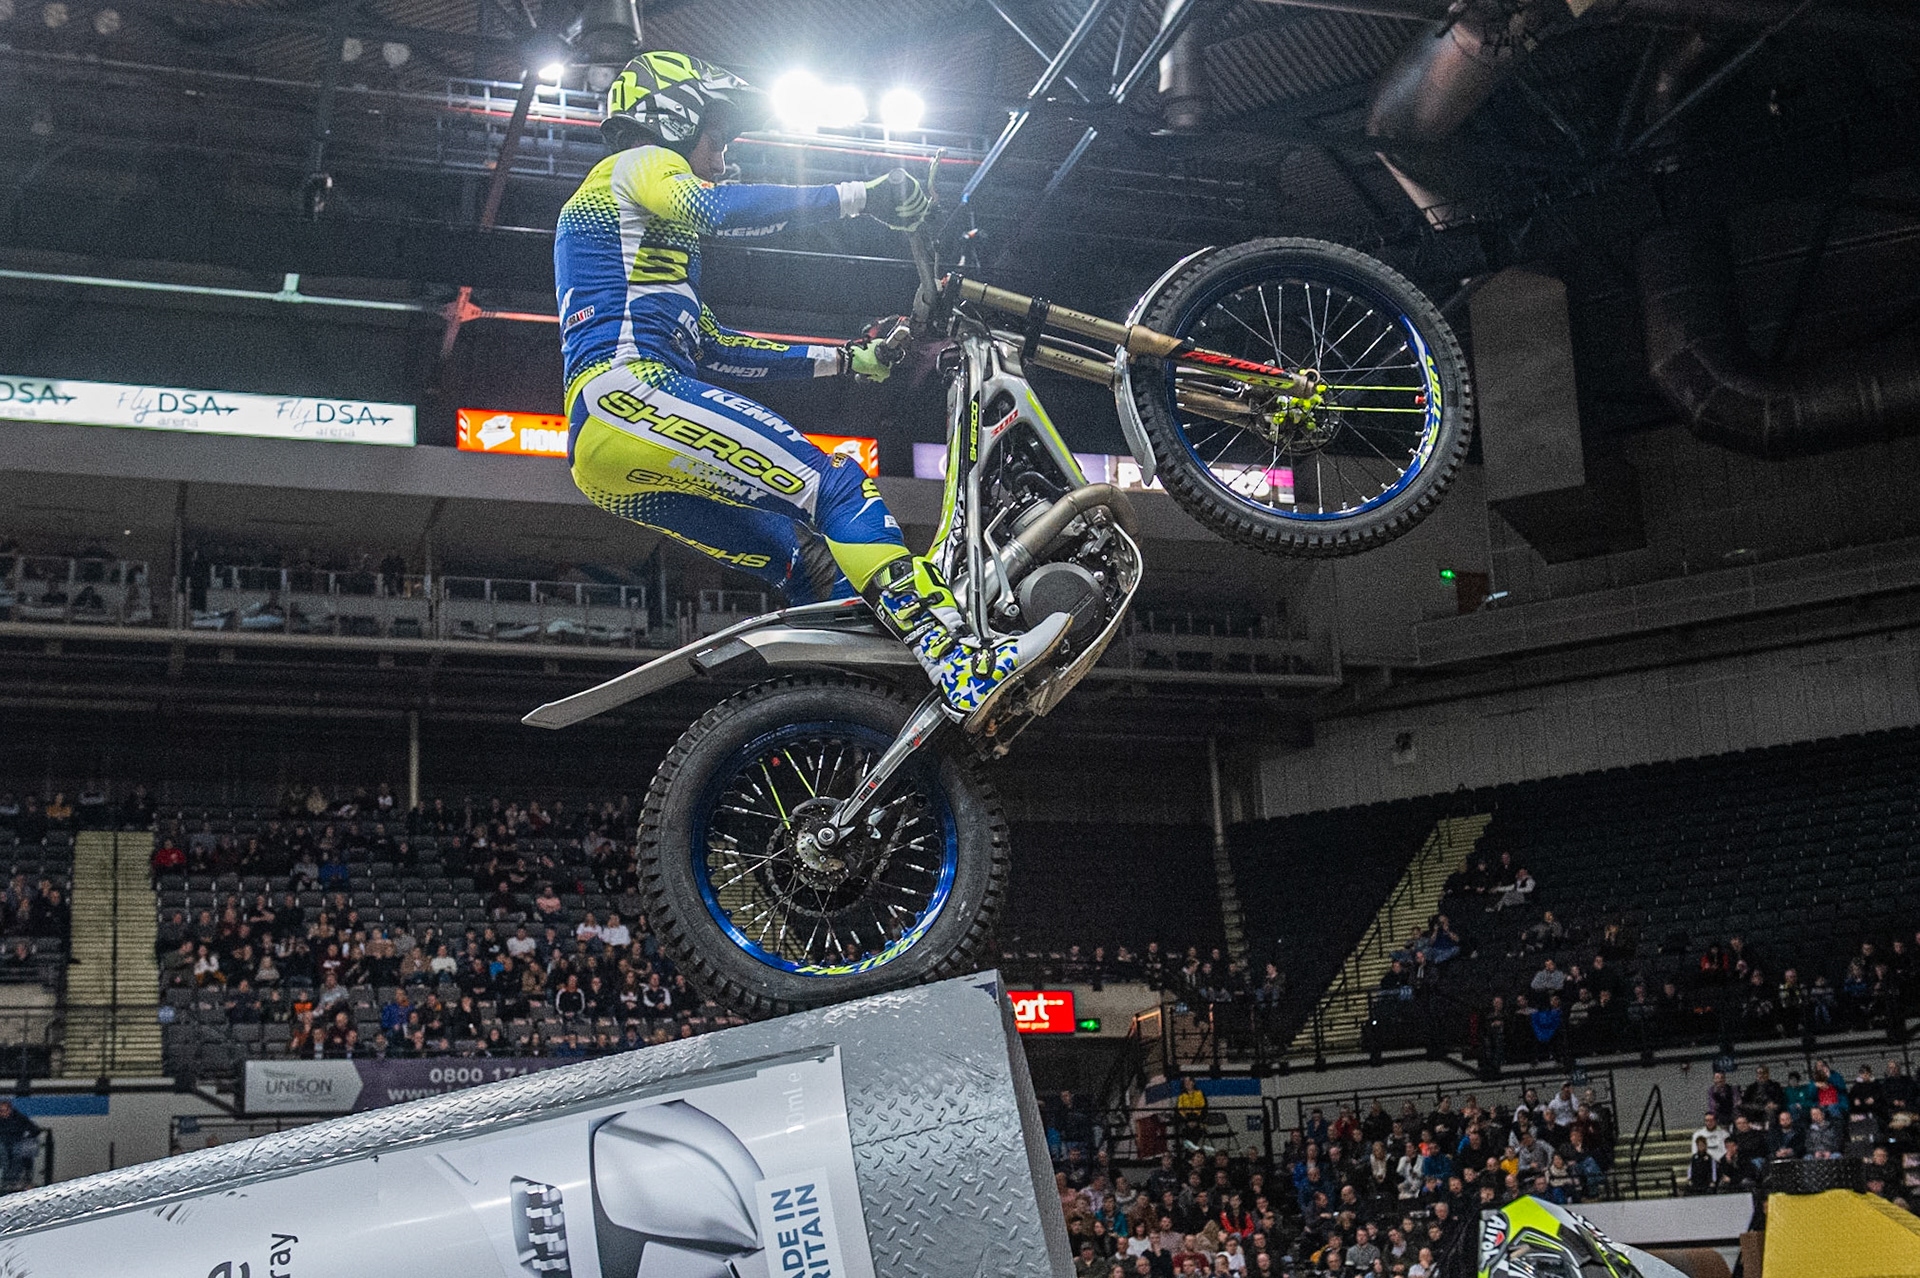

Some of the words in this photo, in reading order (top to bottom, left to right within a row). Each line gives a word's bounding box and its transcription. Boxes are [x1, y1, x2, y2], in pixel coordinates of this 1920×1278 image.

[698, 315, 790, 352] SHERCO
[701, 388, 810, 443] KENNY
[969, 401, 979, 462] SHERCO
[597, 390, 805, 495] SHERCO
[795, 929, 924, 976] FACTORY
[265, 1080, 333, 1095] UNISON
[430, 1068, 484, 1083] 0800
[771, 1189, 796, 1222] IN
